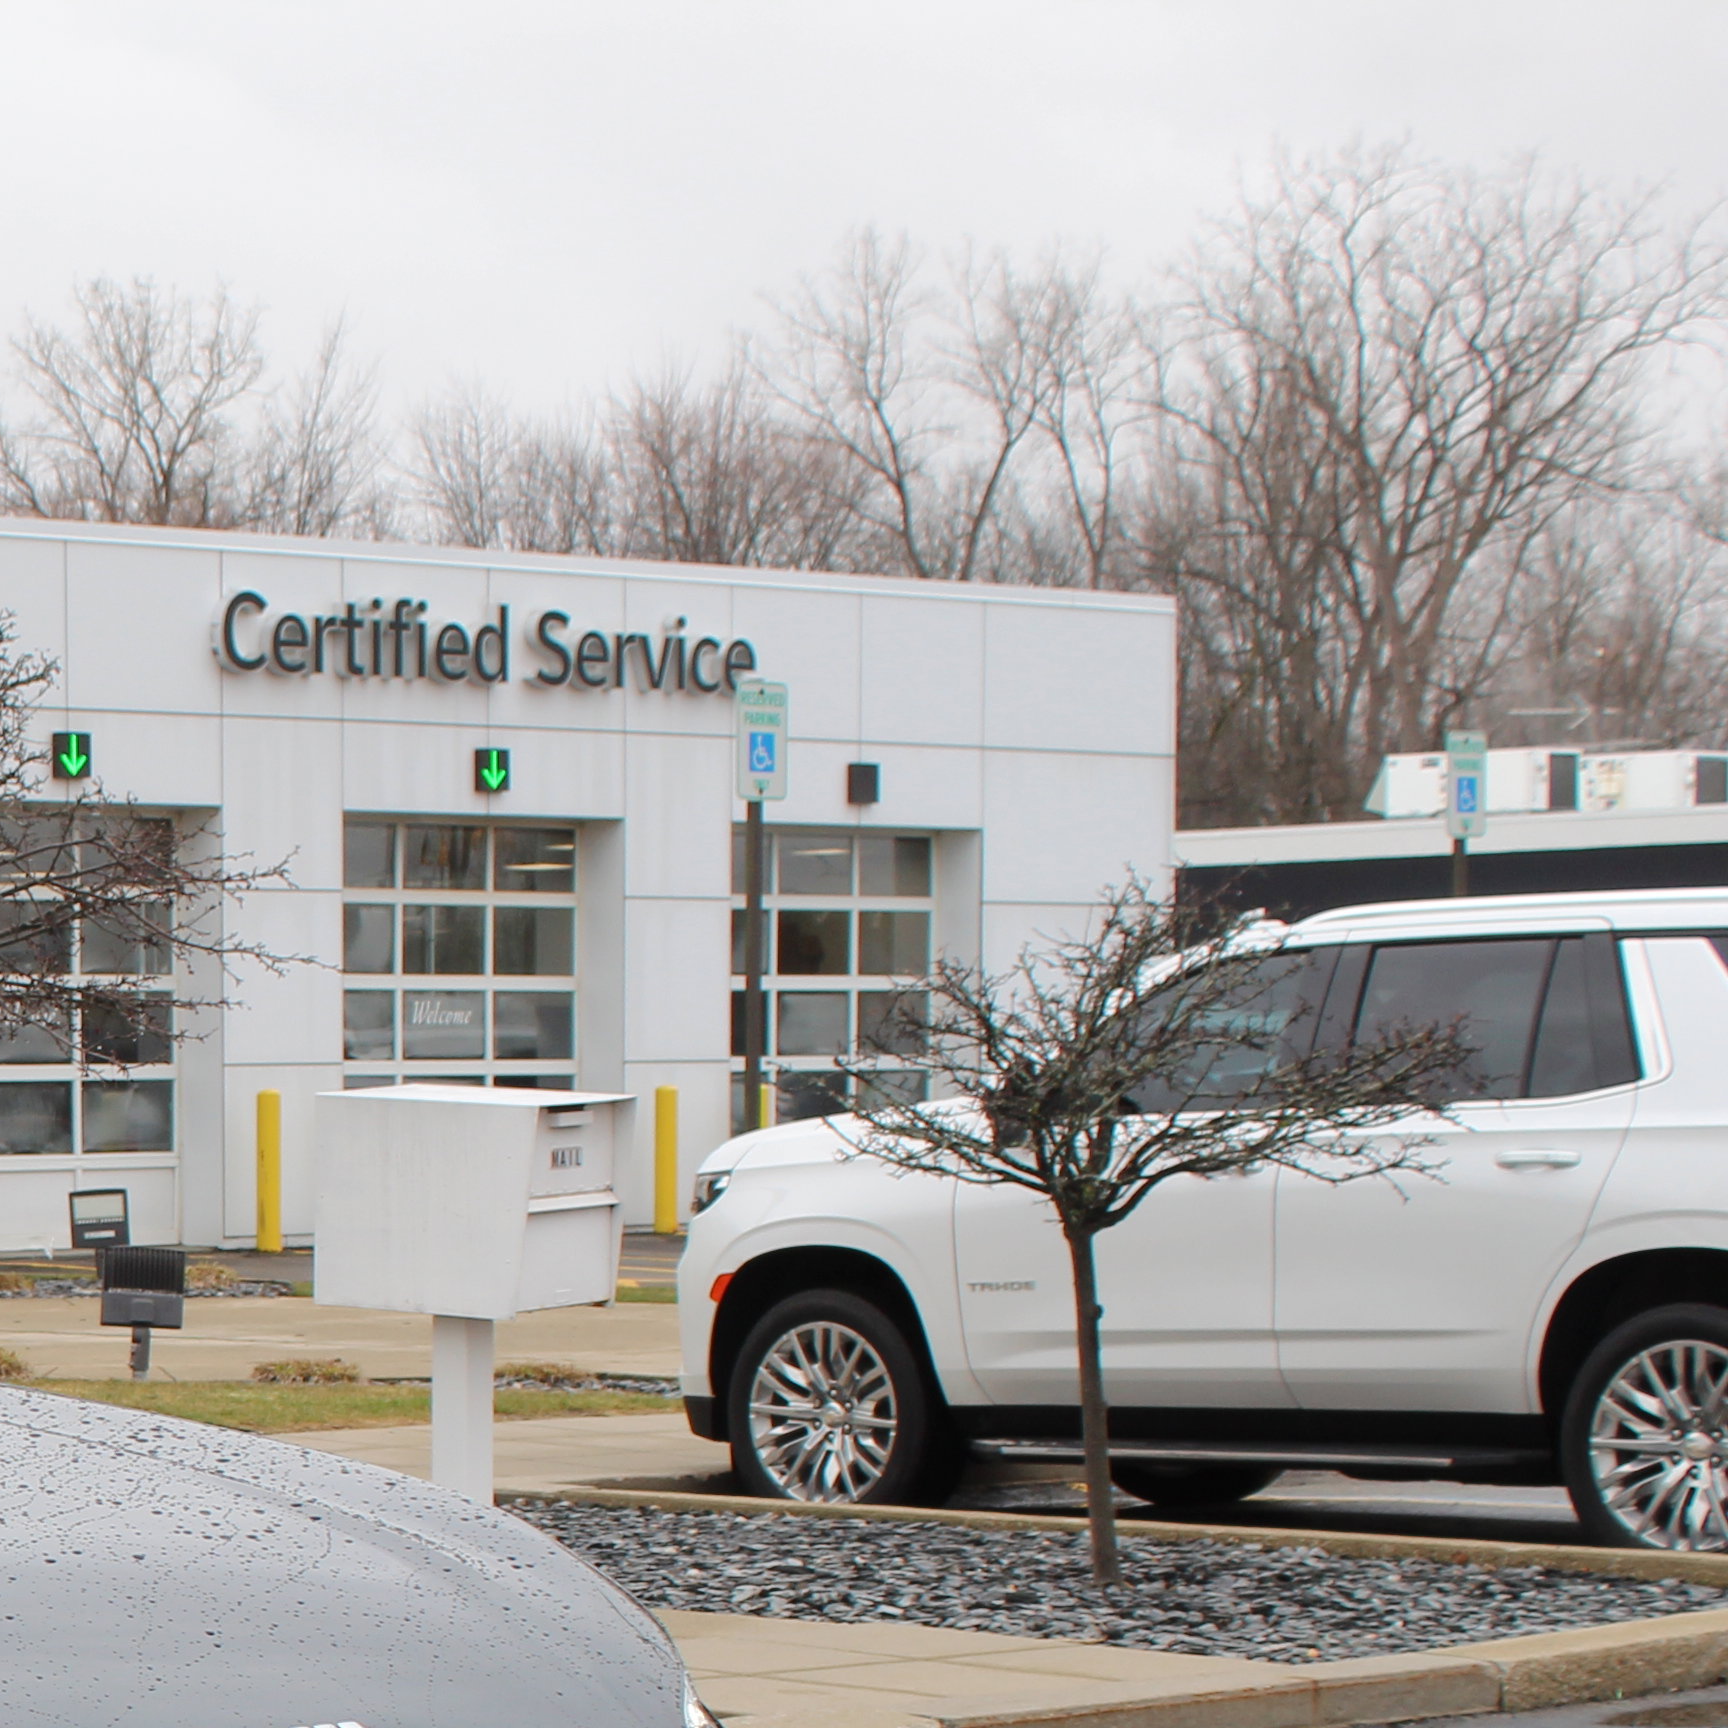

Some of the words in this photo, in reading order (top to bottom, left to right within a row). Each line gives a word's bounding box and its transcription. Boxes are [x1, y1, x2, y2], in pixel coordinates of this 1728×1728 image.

[220, 588, 511, 683] Certified
[534, 609, 758, 694] Service
[411, 1000, 473, 1025] Welcome
[550, 1147, 583, 1168] MAIL
[966, 1280, 1037, 1292] TAHOE
